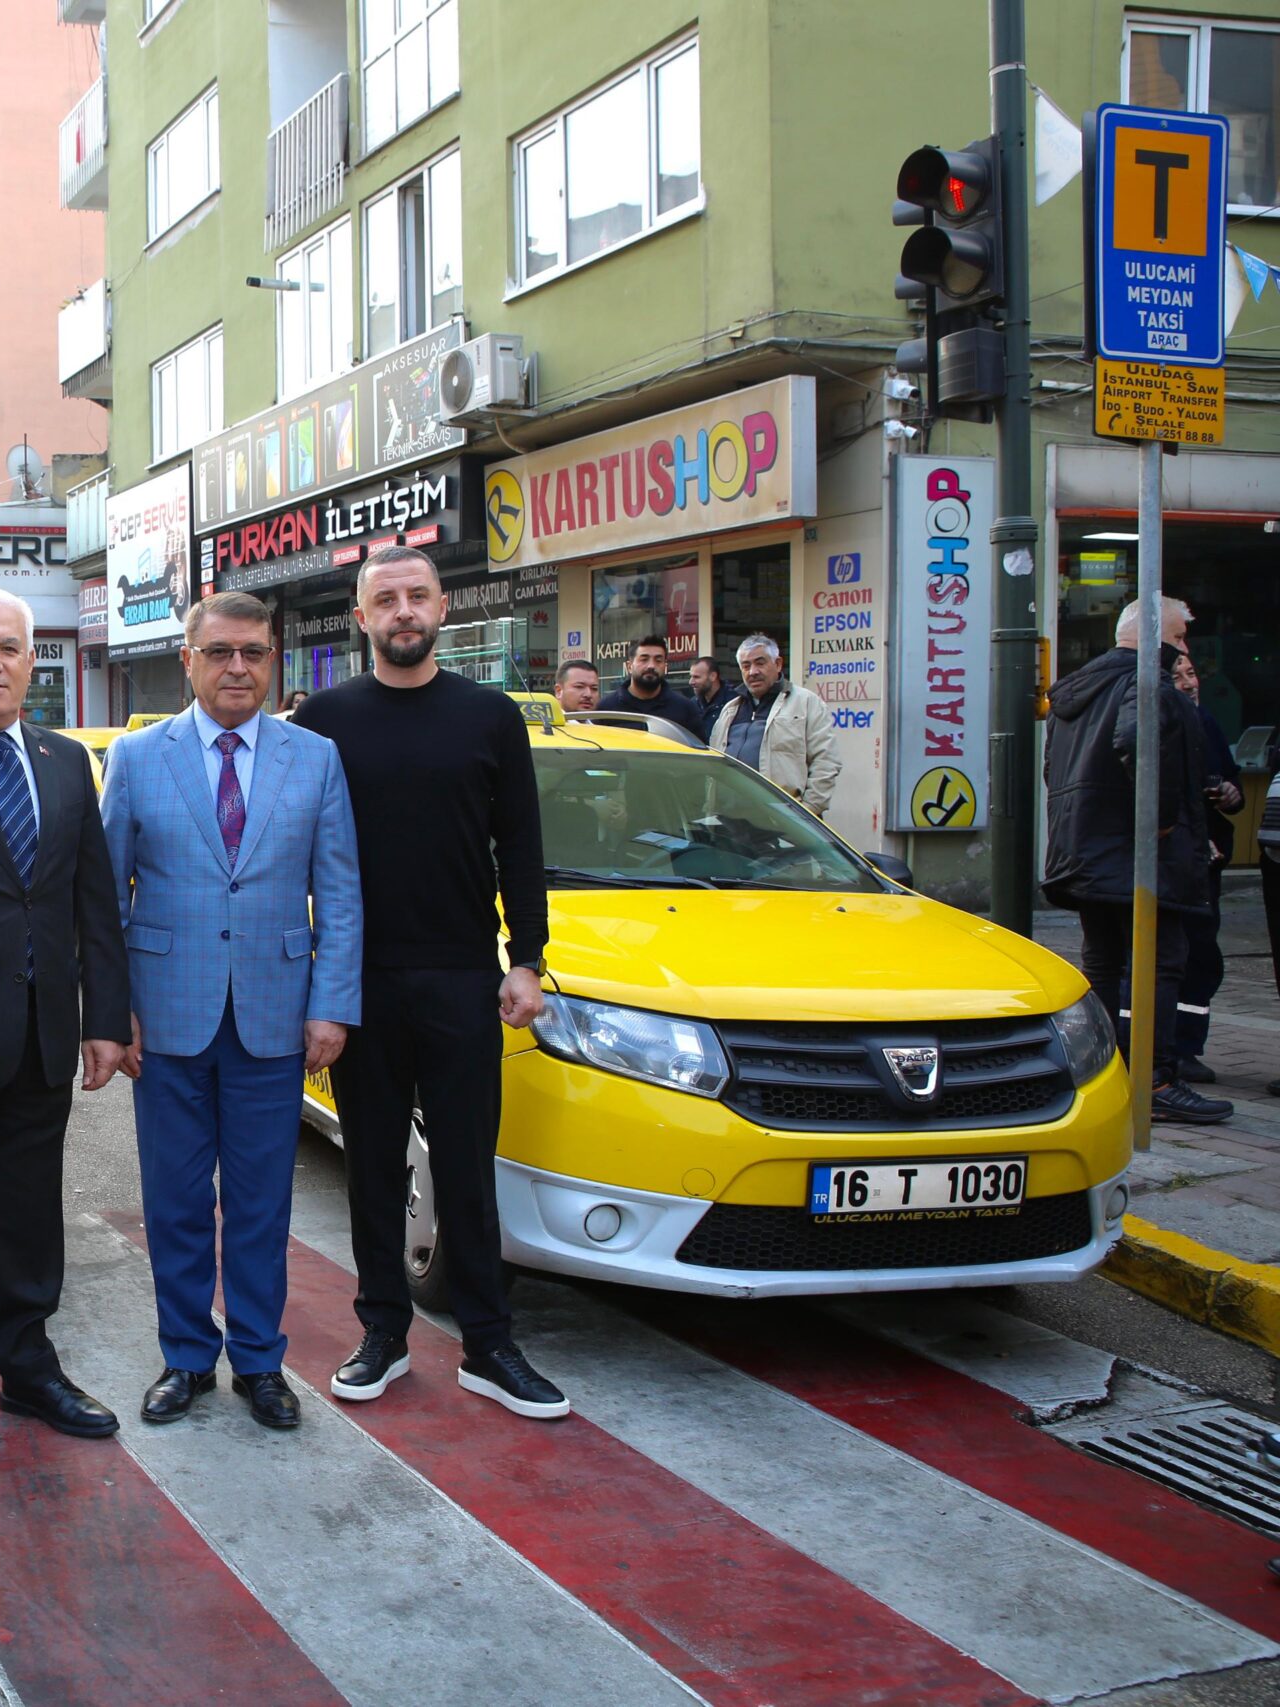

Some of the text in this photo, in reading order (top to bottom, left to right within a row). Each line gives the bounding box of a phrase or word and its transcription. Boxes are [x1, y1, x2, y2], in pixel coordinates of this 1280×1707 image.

[1135, 149, 1189, 240] T
[1125, 261, 1195, 284] ULUCAMİ
[1127, 286, 1193, 308] MEYDAN
[1137, 310, 1184, 331] TAKSİ
[1150, 334, 1180, 348] ARAÇ
[383, 337, 446, 377] AKSESUAR
[1103, 369, 1171, 390] İSTANBUL
[1187, 381, 1218, 395] SAW
[1126, 363, 1194, 380] ULUDAĞ
[1161, 391, 1217, 407] TRANSFER
[1134, 402, 1164, 416] BUDO
[1177, 407, 1217, 422] YALOVA
[1136, 415, 1185, 429] ŞELALE
[1185, 431, 1198, 441] 88
[1201, 432, 1214, 443] 88
[530, 411, 778, 538] KARTUSHOP
[325, 470, 446, 542] İLETİŞİM
[120, 513, 141, 542] CEP
[216, 504, 317, 572] FURKAN
[453, 581, 510, 611] ALINIR-SATILIR
[515, 586, 534, 600] CAM
[813, 587, 872, 610] Canon
[124, 602, 149, 626] EKRAN
[149, 597, 170, 620] BANK
[815, 611, 871, 633] EPSON
[925, 468, 971, 757] KARTUSHOP
[296, 616, 321, 637] TAMİR
[597, 641, 630, 659] KART
[810, 636, 875, 655] LEXMARK
[809, 657, 876, 676] Panasonic
[832, 707, 874, 729] ther
[897, 1054, 933, 1063] DACIA
[814, 1163, 1022, 1208] TR 16 T 1030
[897, 1209, 970, 1221] MEYDAN
